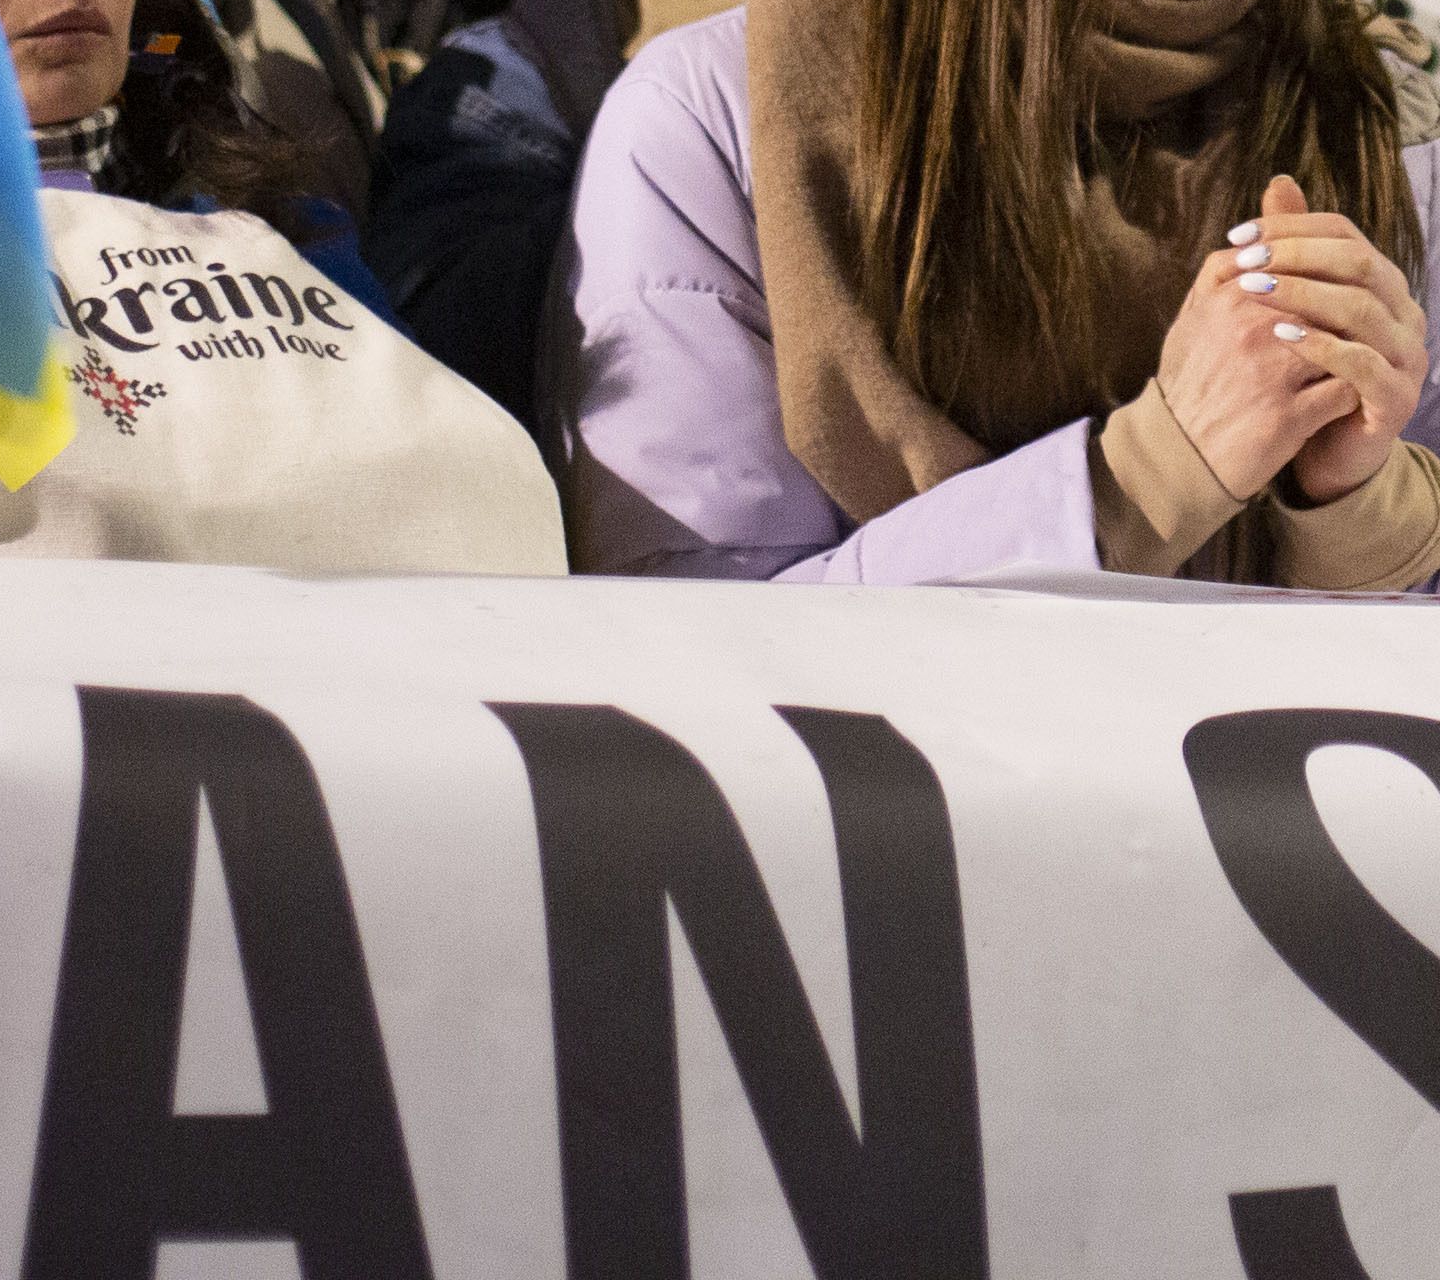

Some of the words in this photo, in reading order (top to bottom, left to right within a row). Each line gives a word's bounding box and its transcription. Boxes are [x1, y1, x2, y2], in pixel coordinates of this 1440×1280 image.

[97, 244, 197, 285] from
[49, 262, 355, 353] kraine
[177, 329, 265, 361] with
[266, 325, 348, 362] love
